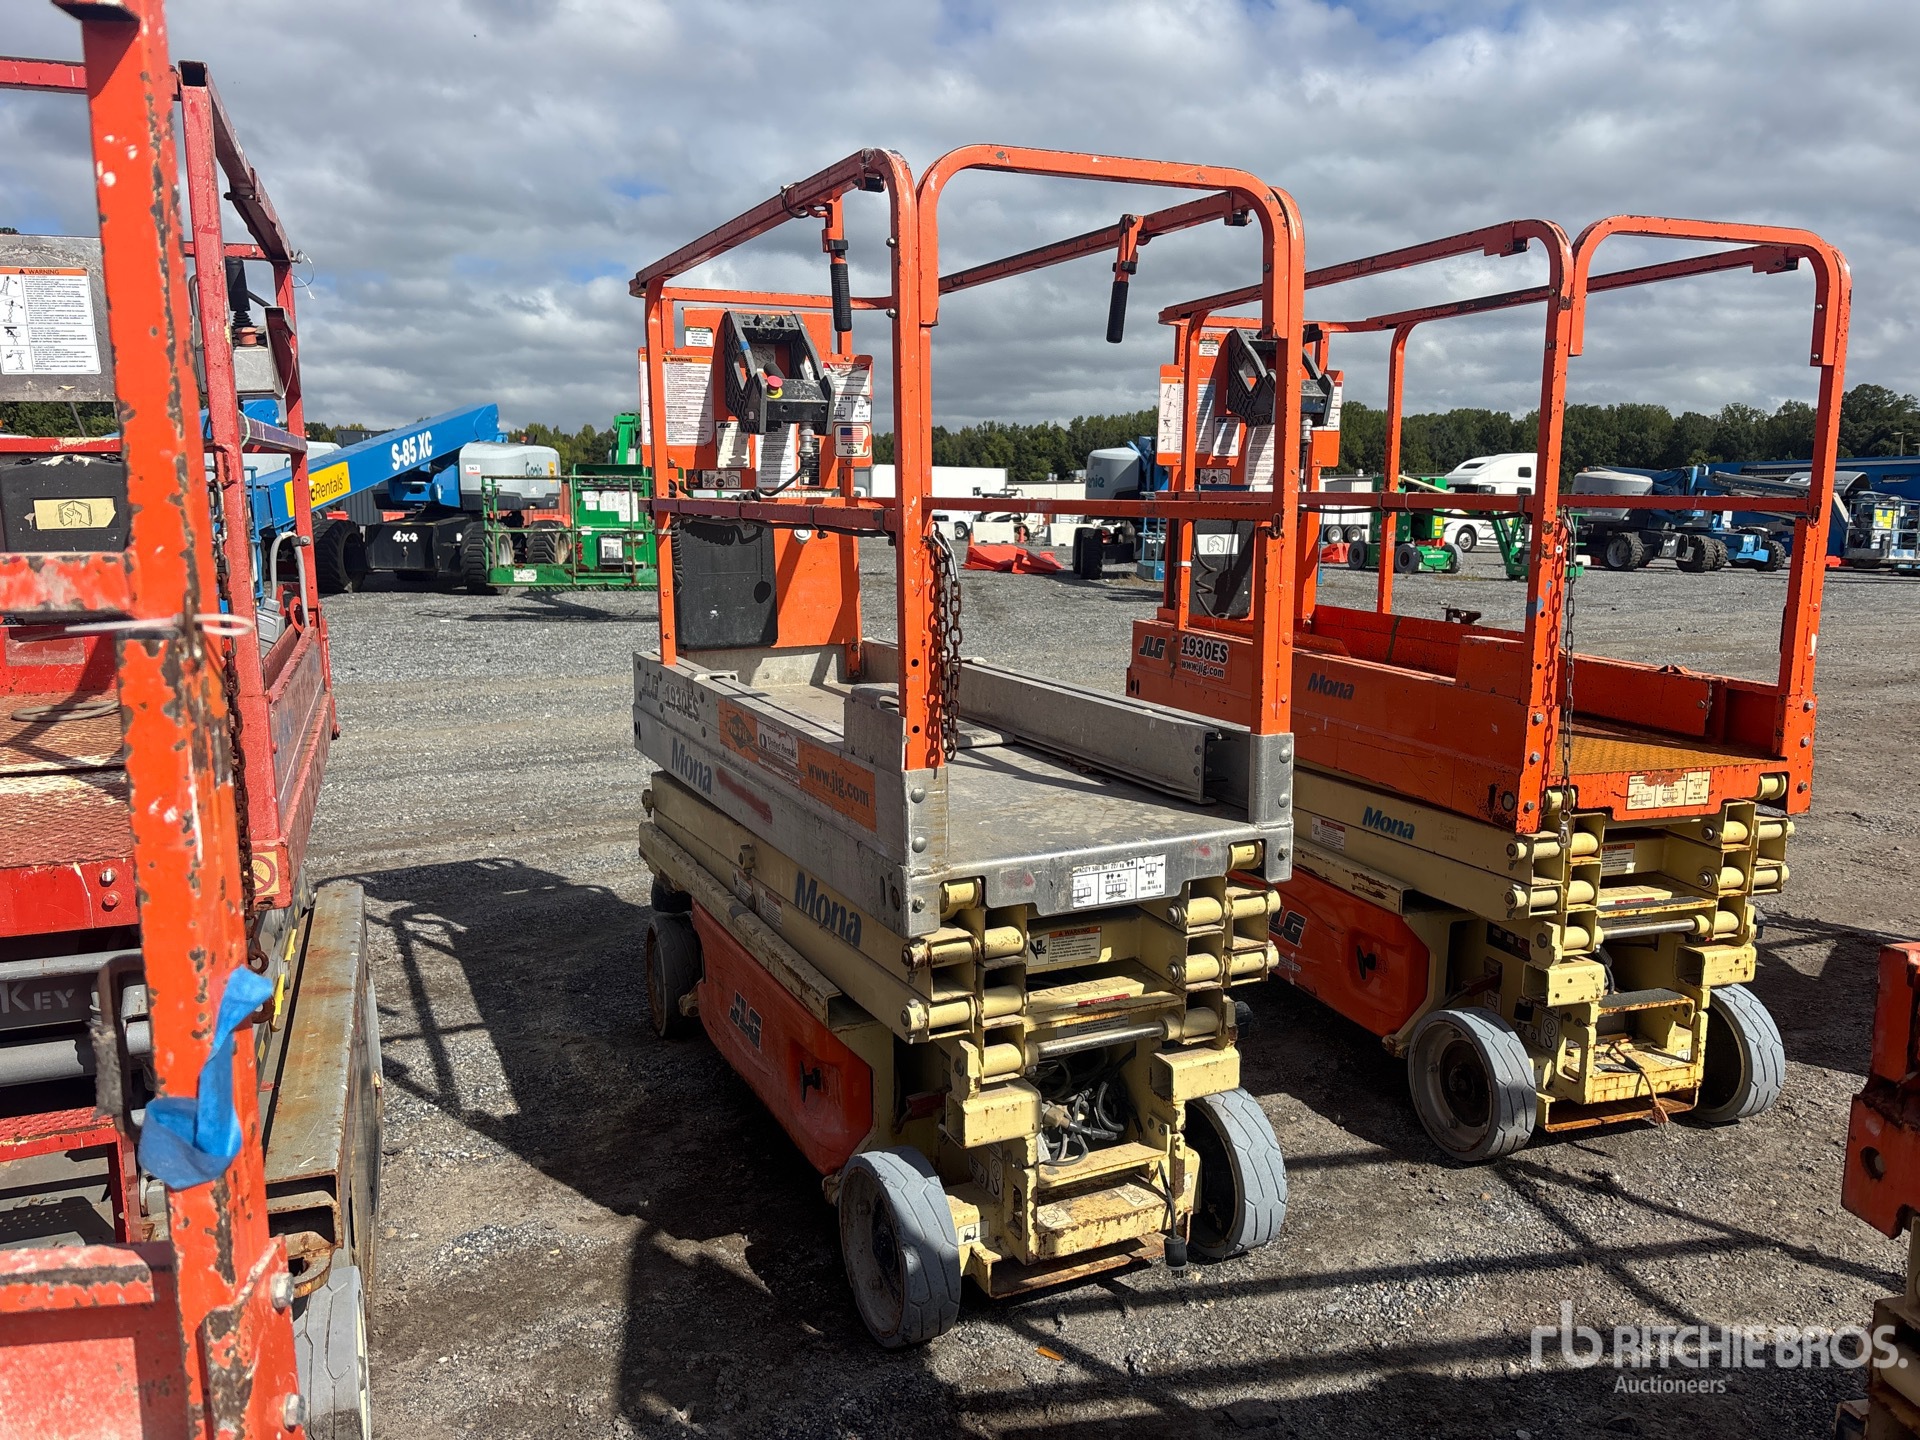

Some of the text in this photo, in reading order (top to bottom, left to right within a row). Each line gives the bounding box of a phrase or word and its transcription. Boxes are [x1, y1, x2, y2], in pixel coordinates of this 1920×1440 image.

[391, 430, 433, 471] S-85 XC
[309, 473, 345, 502] cRentals
[392, 530, 419, 543] 4x4
[1138, 635, 1166, 660] JLG
[1181, 635, 1229, 664] 1930ES
[1181, 659, 1224, 679] www.jlg.com
[1307, 672, 1355, 700] Mona
[665, 682, 700, 723] 1930ES
[671, 736, 713, 795] Mona
[806, 761, 870, 808] www.jlg.com
[1362, 806, 1416, 840] Mona
[795, 870, 862, 948] Mona
[1268, 905, 1307, 947] LG
[1065, 928, 1091, 937] WARNING
[728, 990, 763, 1050] JLG
